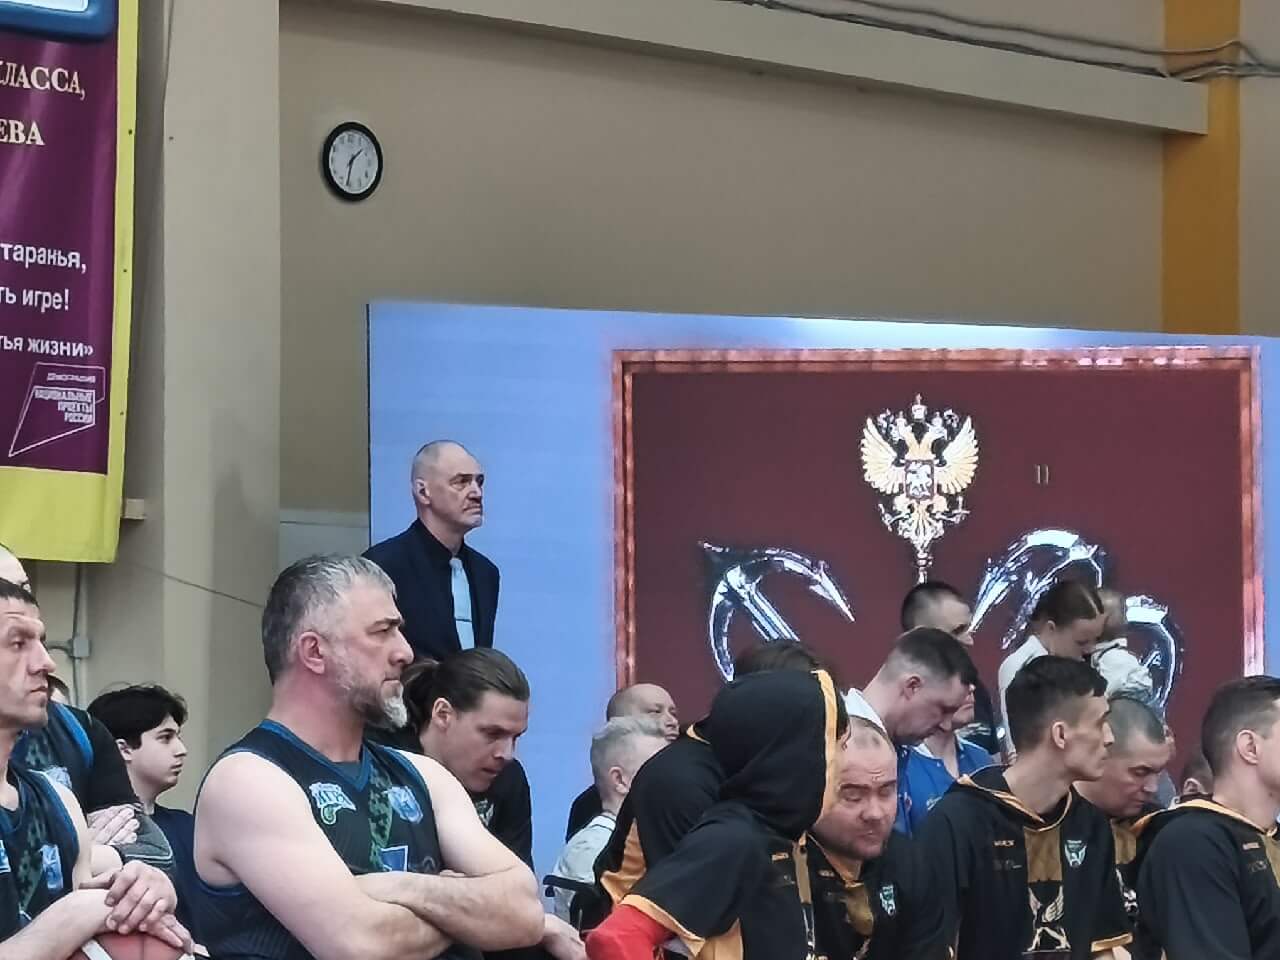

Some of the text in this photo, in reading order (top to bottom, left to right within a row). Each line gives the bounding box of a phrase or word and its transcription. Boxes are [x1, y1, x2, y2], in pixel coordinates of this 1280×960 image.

[0, 243, 87, 274] таранья,
[22, 288, 69, 314] игре!
[27, 337, 94, 357] жизни»
